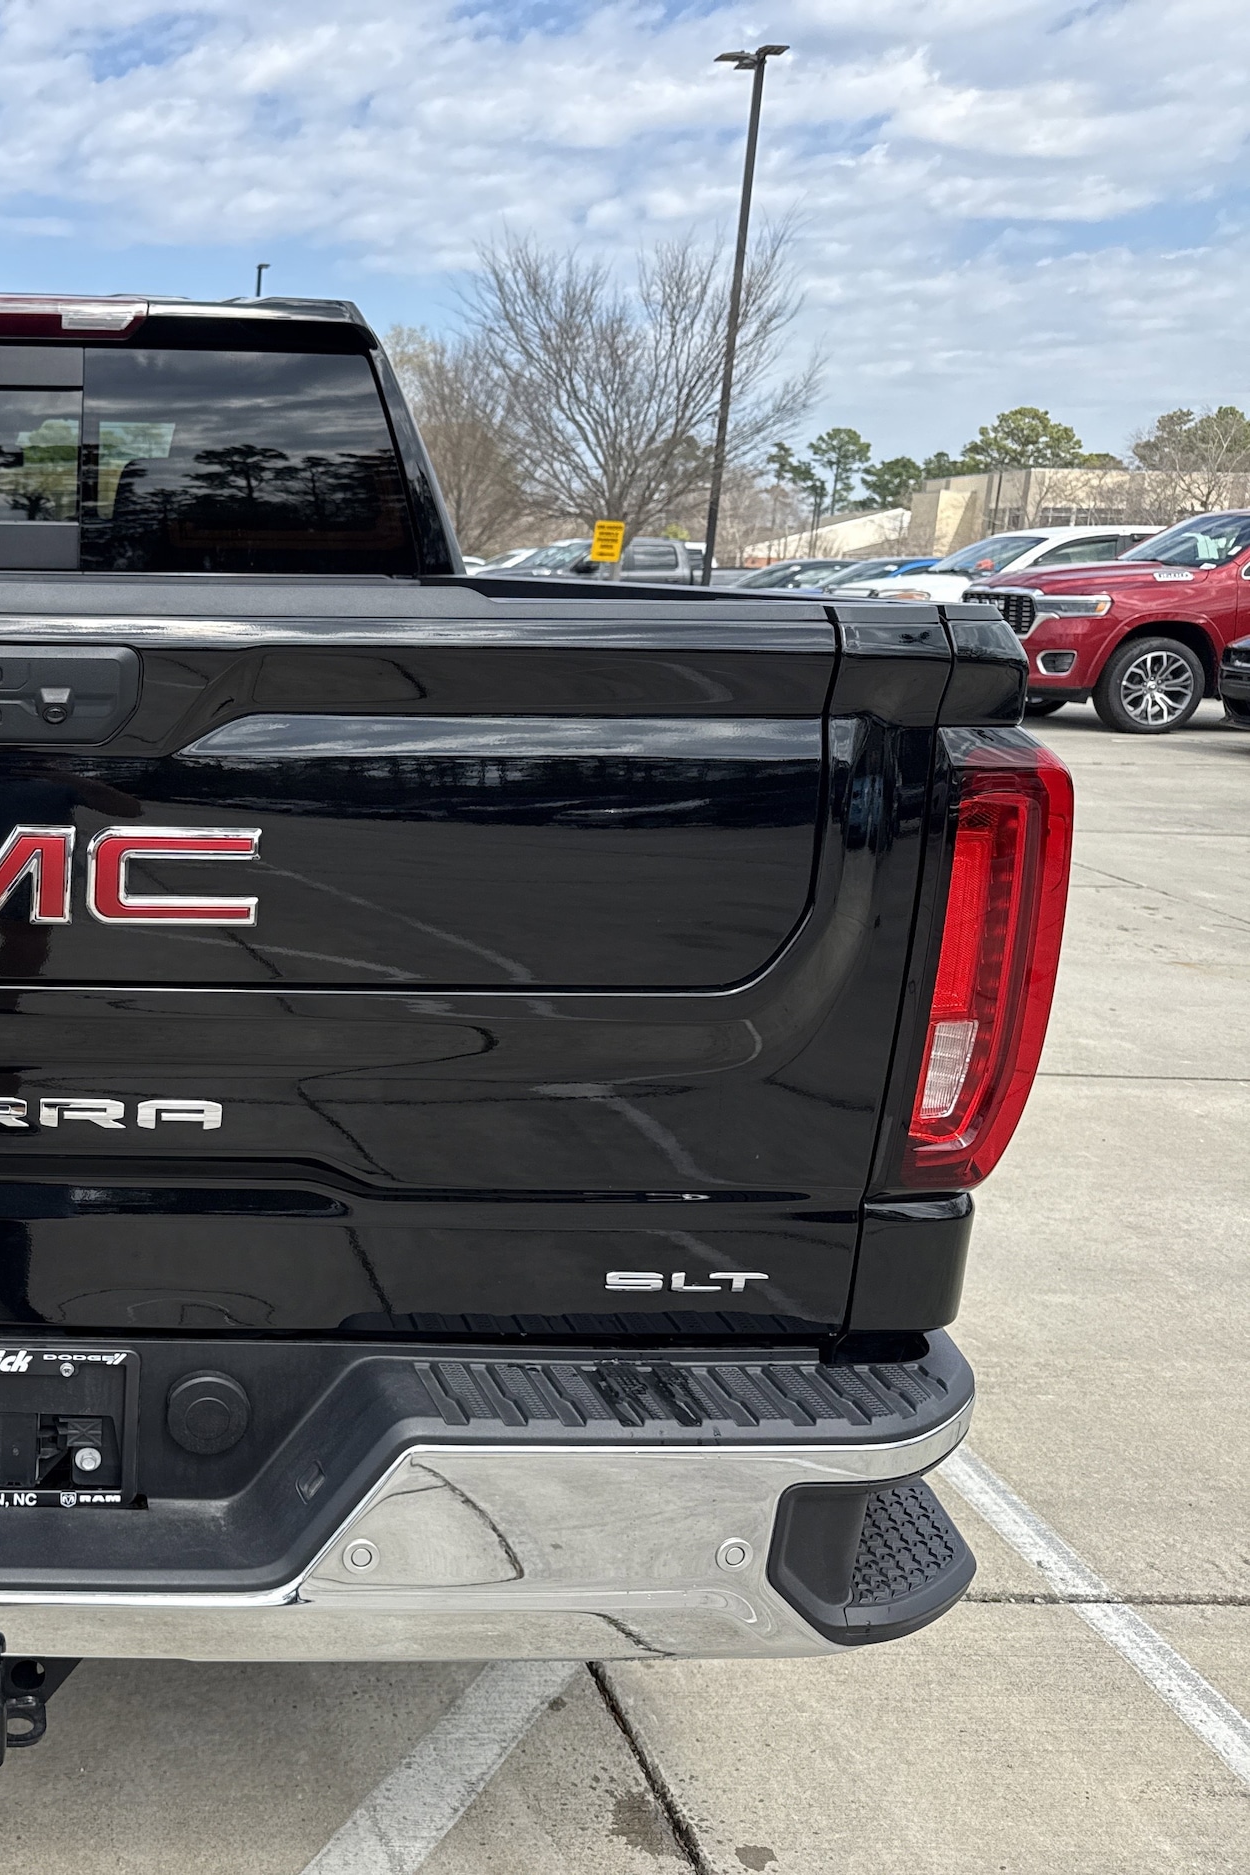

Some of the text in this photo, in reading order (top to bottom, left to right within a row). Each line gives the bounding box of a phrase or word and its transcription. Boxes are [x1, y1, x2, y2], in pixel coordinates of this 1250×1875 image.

[604, 1271, 770, 1293] SLT
[42, 1353, 116, 1362] DODGE
[13, 1491, 38, 1507] NC
[79, 1494, 121, 1503] RAM
